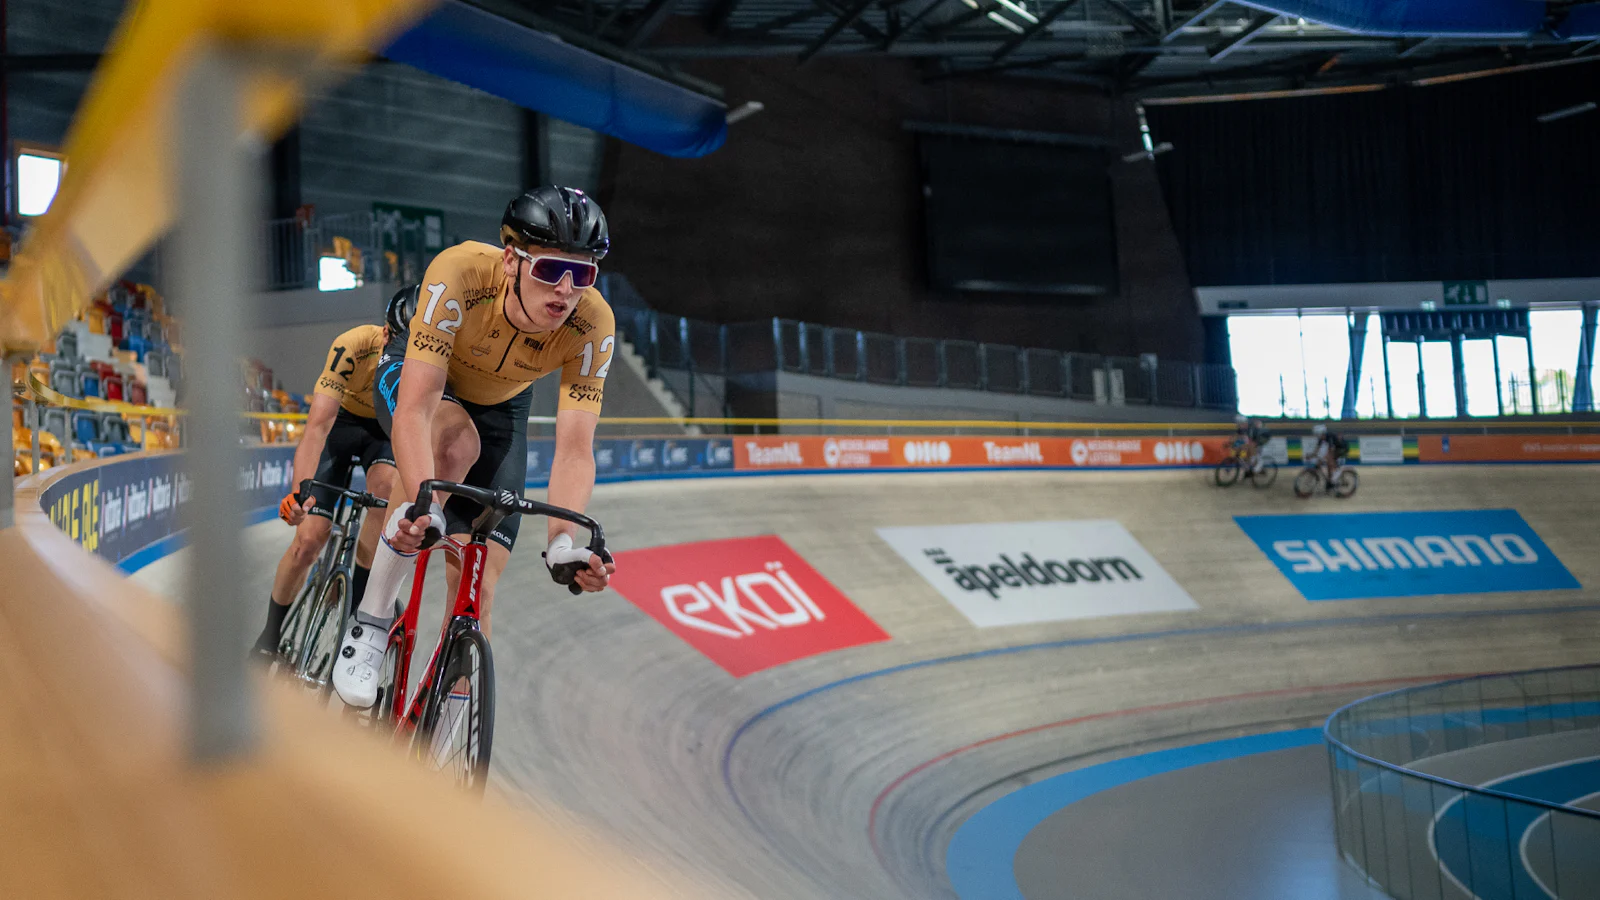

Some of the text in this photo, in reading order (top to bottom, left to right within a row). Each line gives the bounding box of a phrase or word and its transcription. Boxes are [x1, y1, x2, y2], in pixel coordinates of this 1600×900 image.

[423, 281, 463, 336] 12
[330, 345, 355, 381] 12
[576, 334, 615, 378] 12
[1273, 533, 1538, 573] SHIMANO
[945, 552, 1144, 600] apeldoorn
